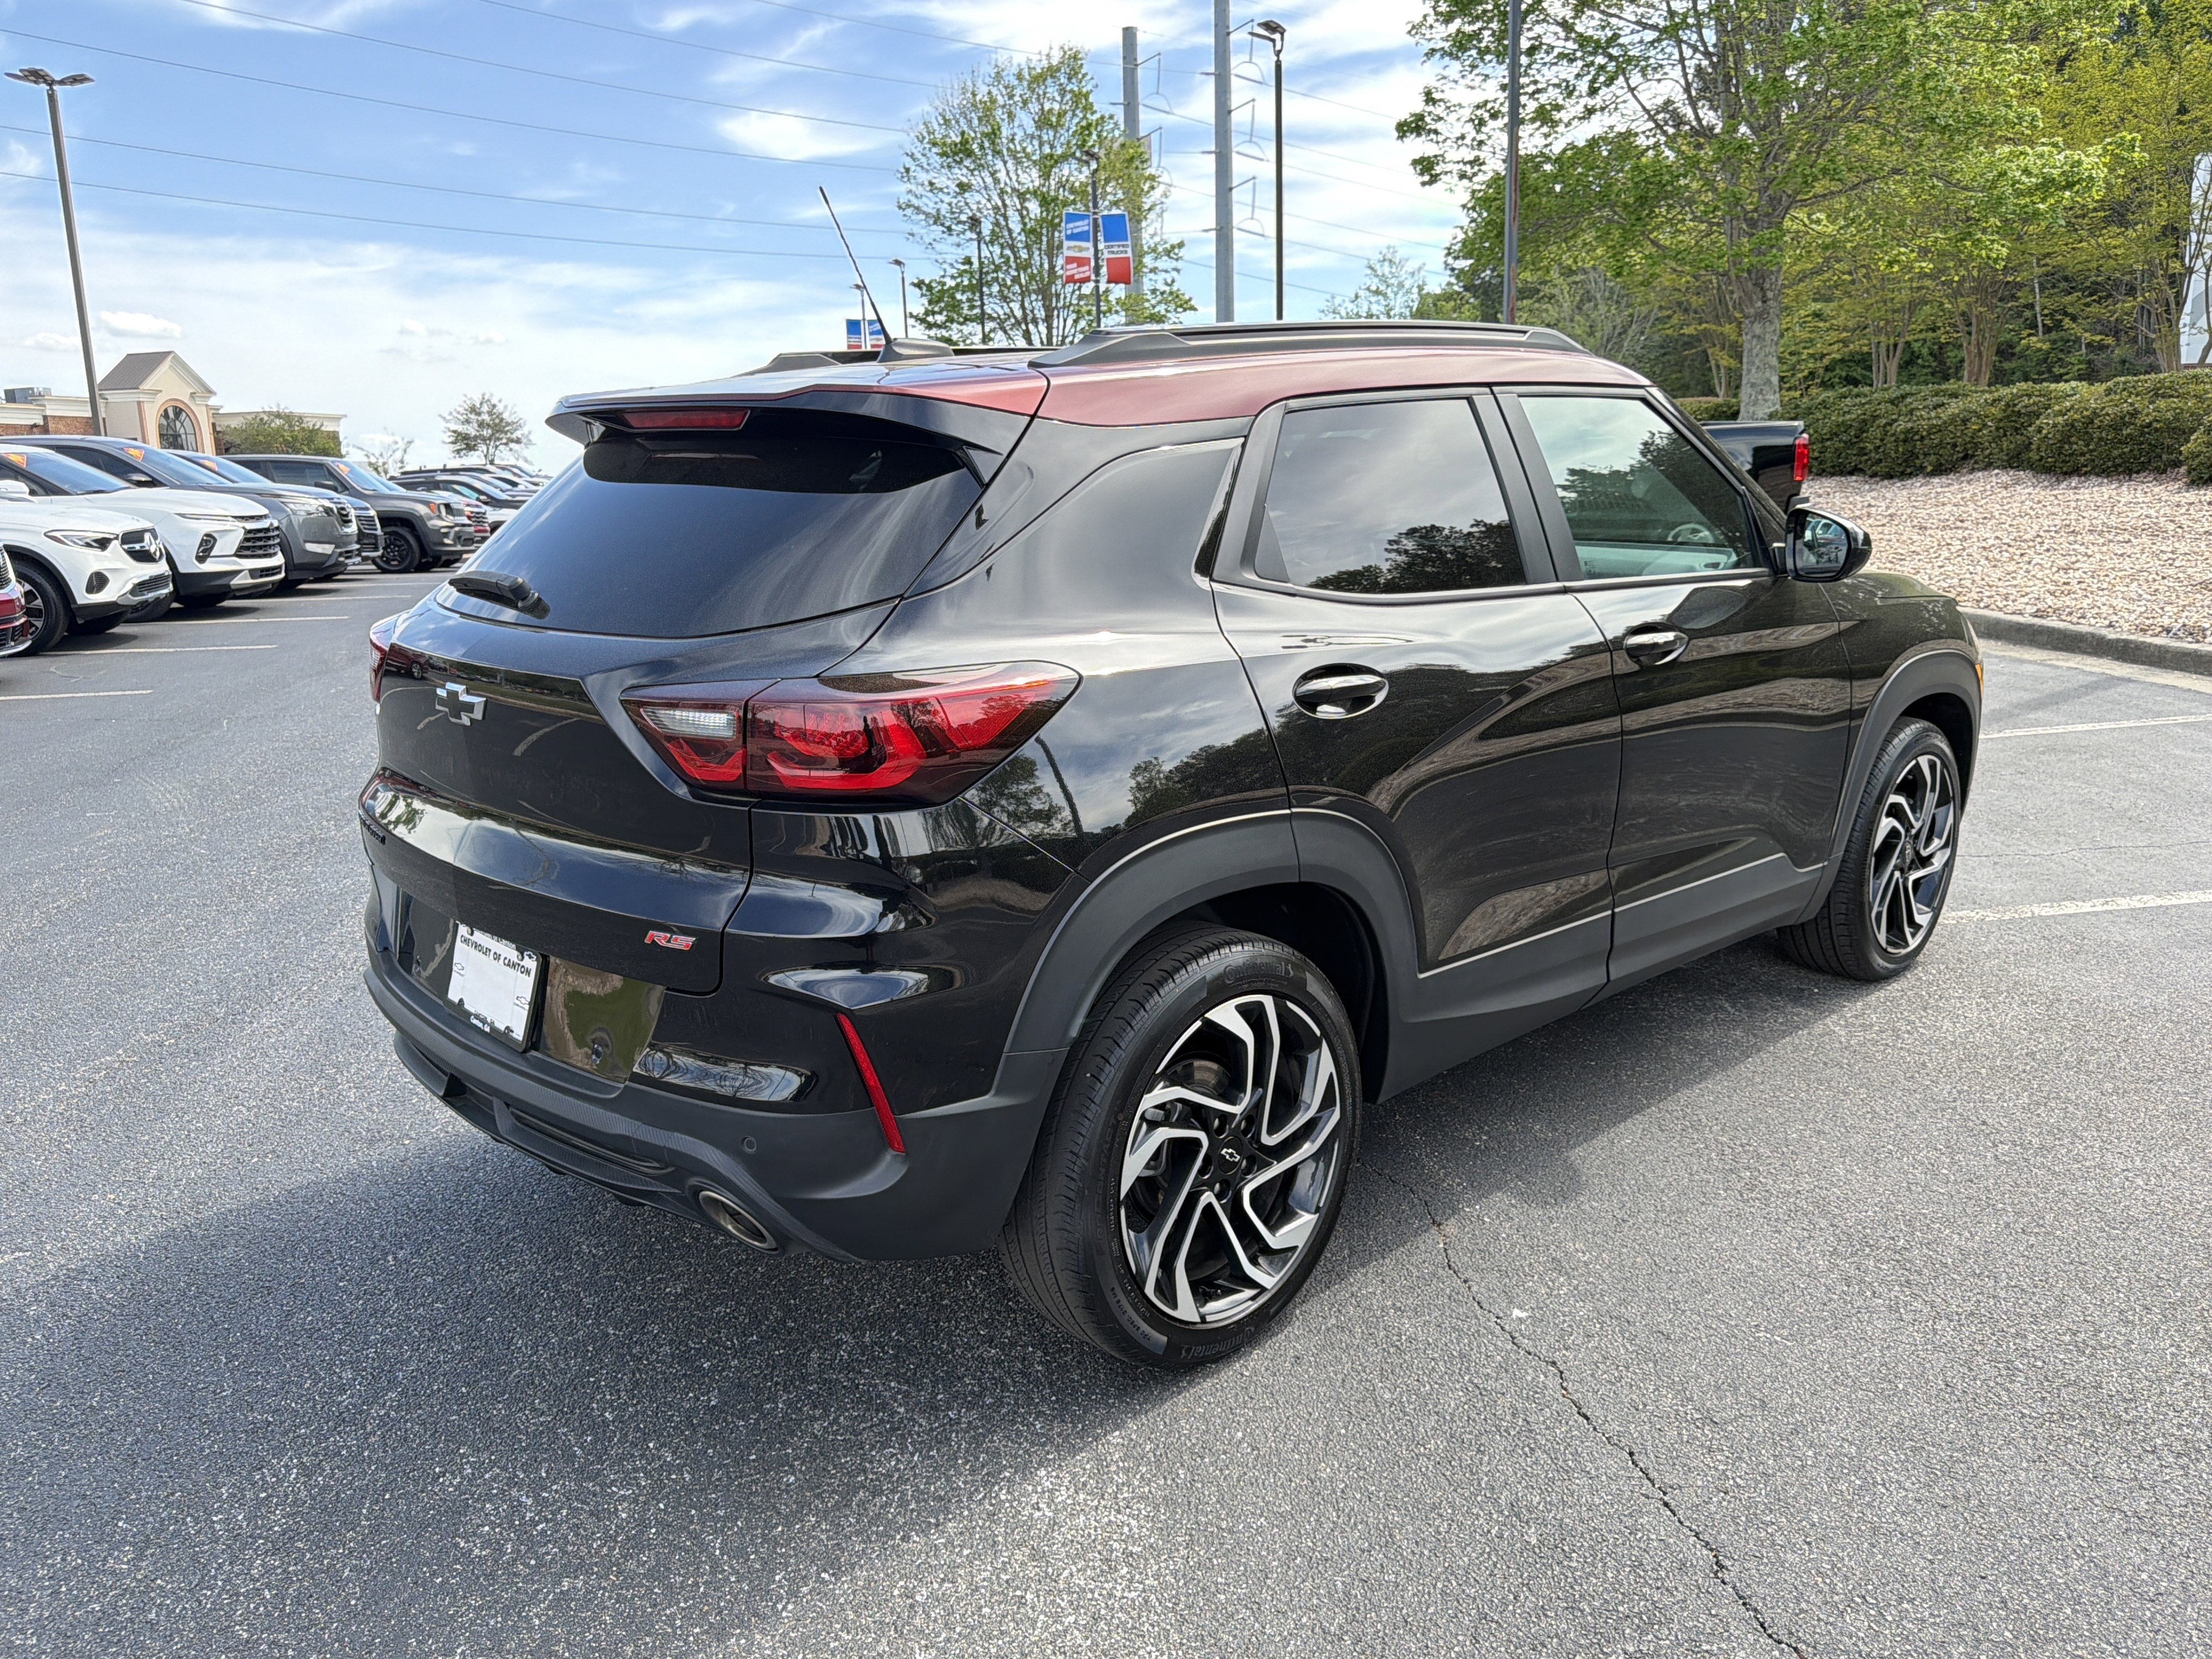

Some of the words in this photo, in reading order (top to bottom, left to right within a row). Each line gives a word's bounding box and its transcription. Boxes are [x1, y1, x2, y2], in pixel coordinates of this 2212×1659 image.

[644, 930, 696, 950] RS
[460, 934, 492, 957] CHEVROLET
[493, 951, 501, 963] OF
[503, 956, 532, 978] CANTON
[1223, 960, 1285, 984] Continental
